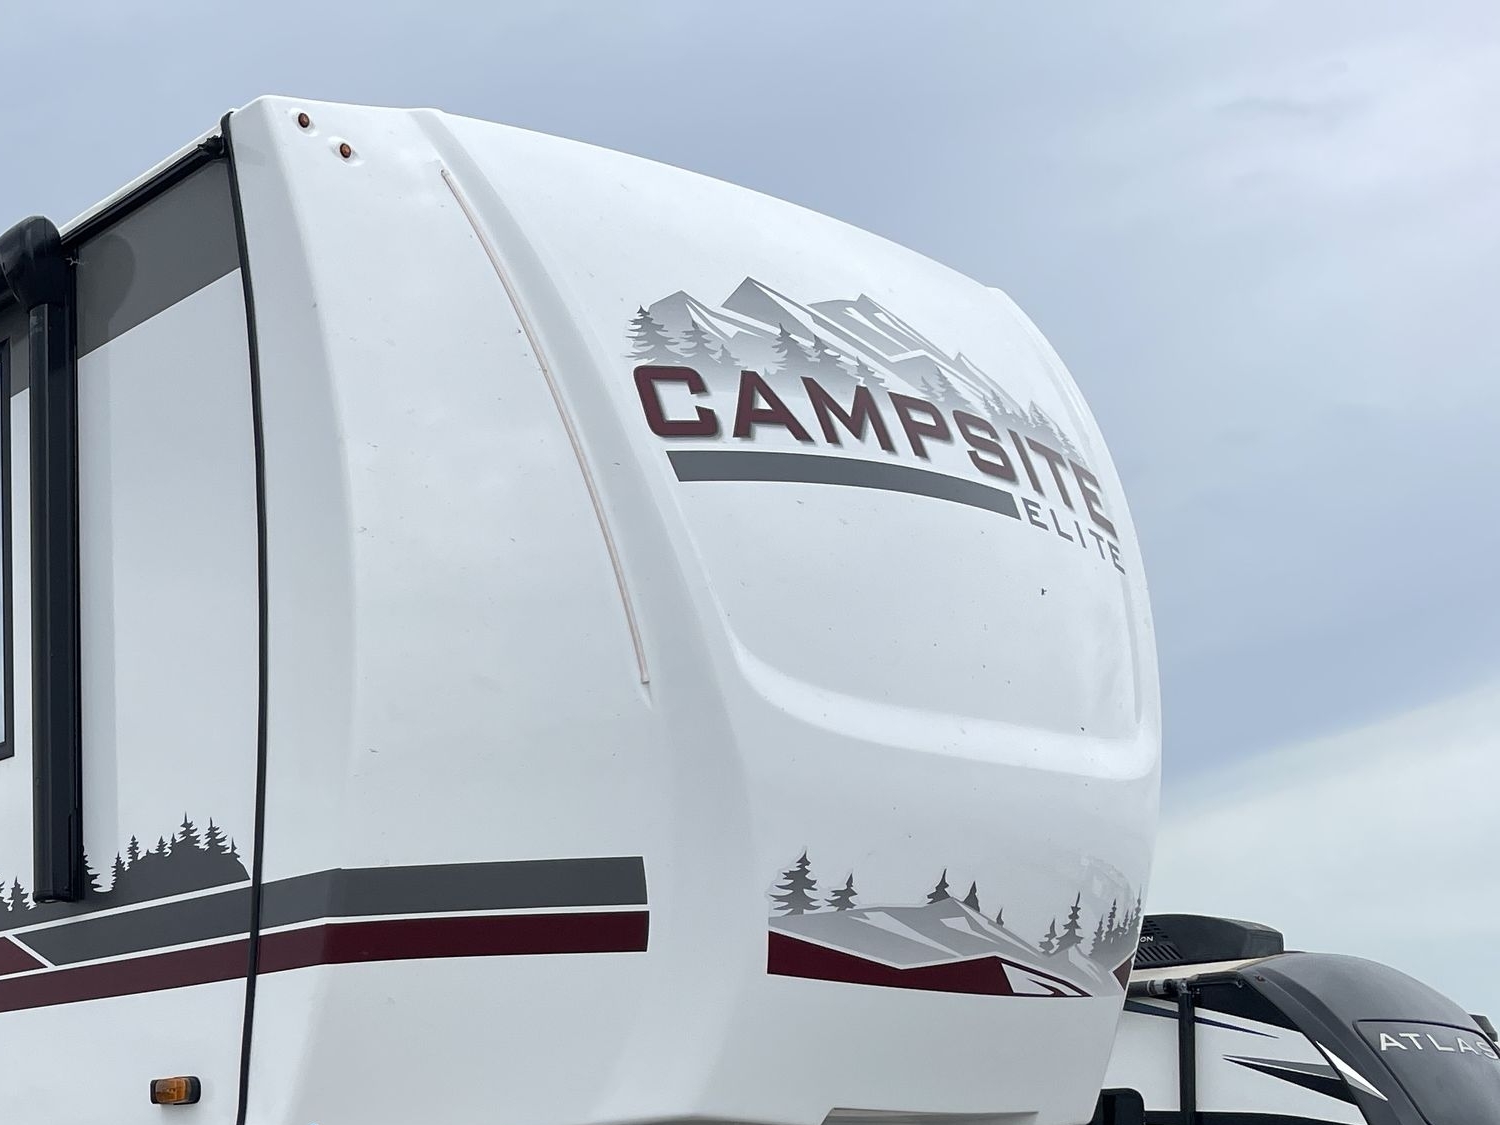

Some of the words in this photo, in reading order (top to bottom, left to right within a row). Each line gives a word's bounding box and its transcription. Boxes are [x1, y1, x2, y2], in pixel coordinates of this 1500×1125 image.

[632, 364, 1118, 540] CAMPSITE
[1020, 496, 1127, 576] ELITE
[1379, 1032, 1499, 1060] ATLAS
